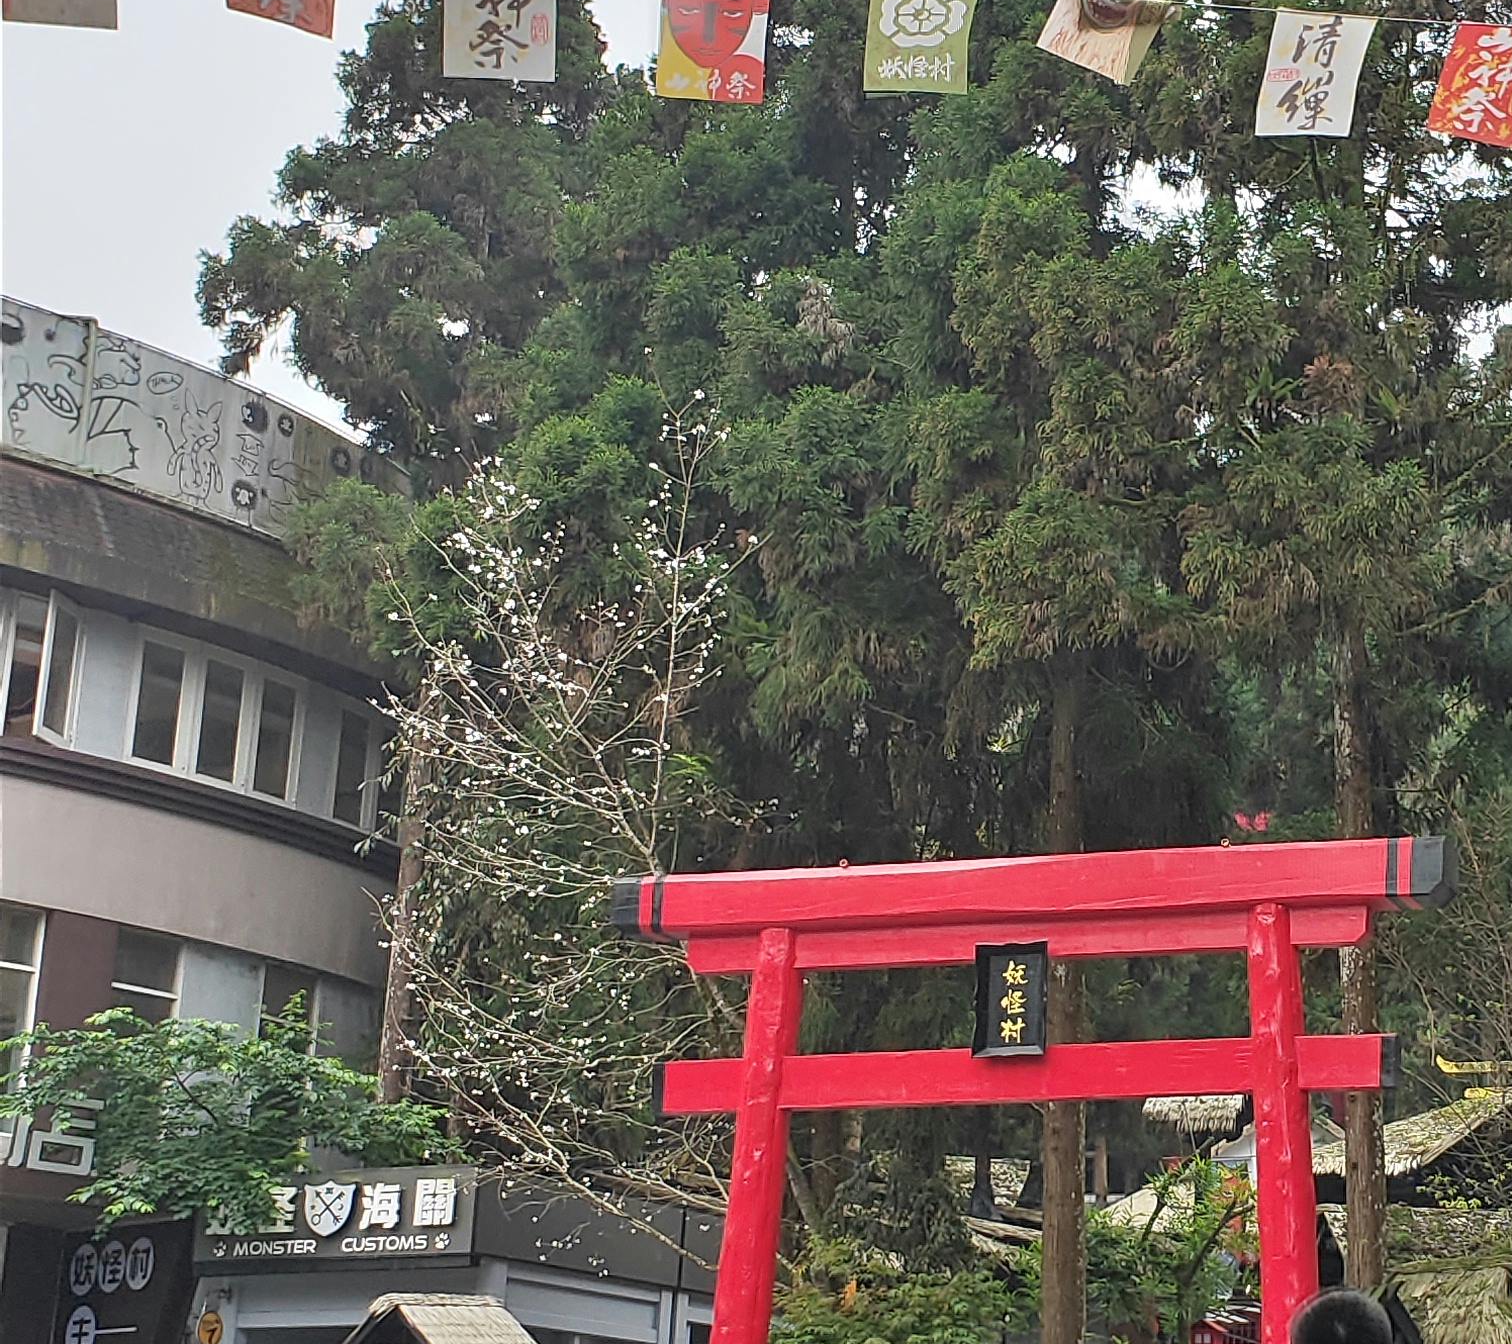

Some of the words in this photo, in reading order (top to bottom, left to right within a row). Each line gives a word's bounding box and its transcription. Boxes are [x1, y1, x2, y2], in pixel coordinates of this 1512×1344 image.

[877, 53, 955, 82] 妖怪村
[359, 1178, 456, 1231] 海關
[233, 1239, 317, 1257] MONSTER
[341, 1234, 428, 1253] CUSTOMS
[73, 1248, 152, 1286] 妖怪村
